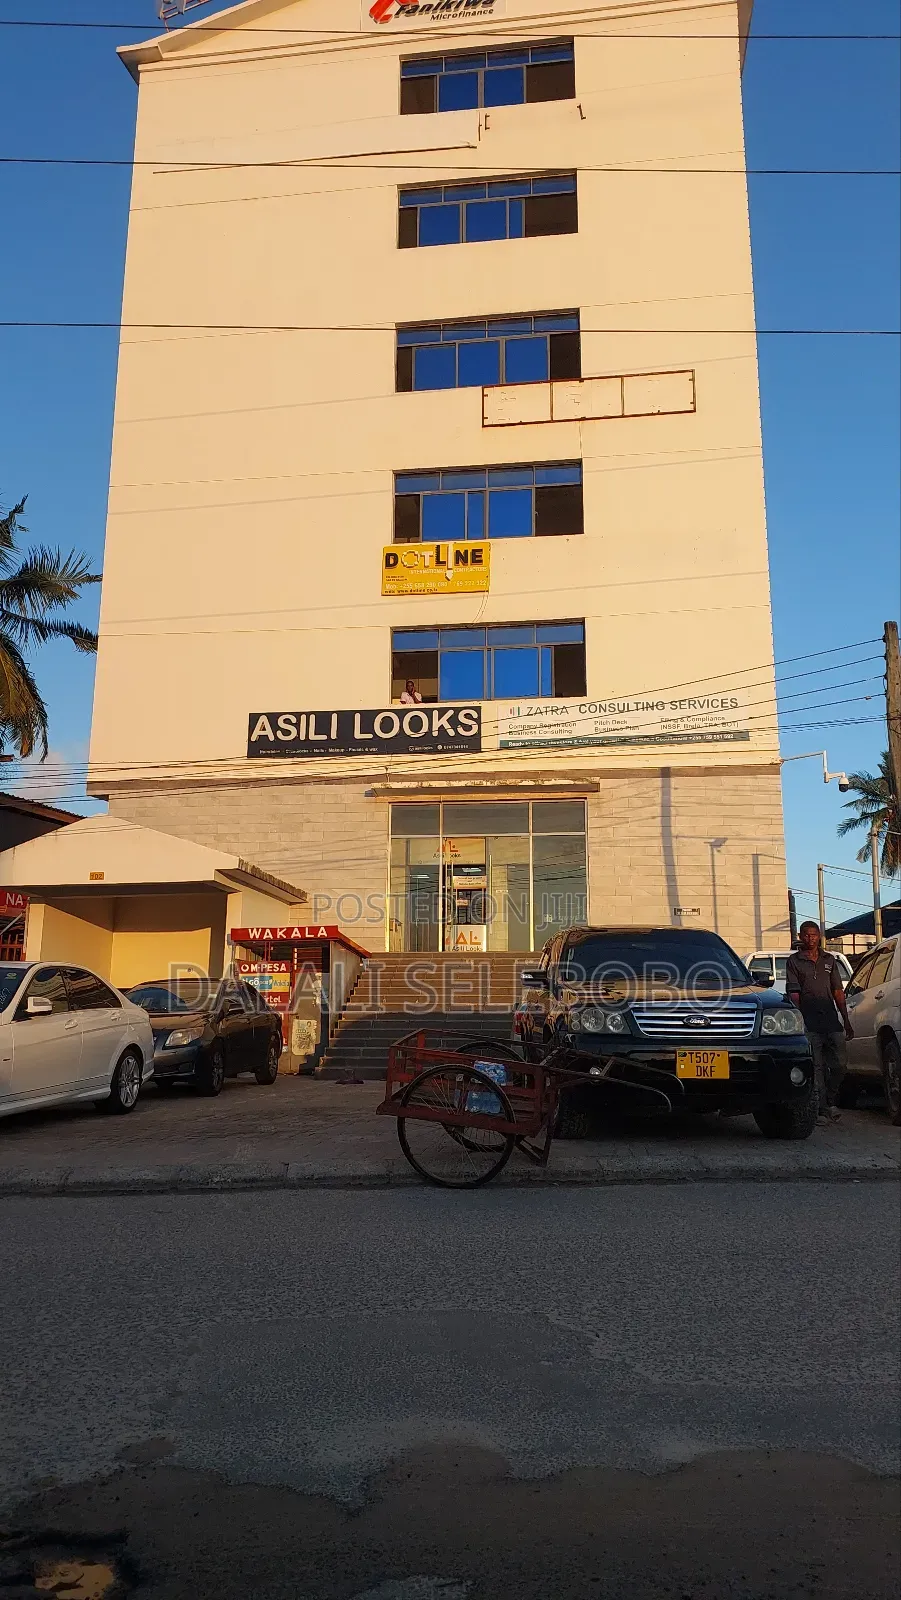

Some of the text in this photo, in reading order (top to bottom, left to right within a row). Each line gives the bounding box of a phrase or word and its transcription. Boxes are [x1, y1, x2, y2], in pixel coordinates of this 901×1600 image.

[430, 8, 494, 22] Microfinance
[385, 544, 484, 574] DOTLINE
[526, 697, 739, 716] ZATRA CONSULTING SERVICES
[250, 708, 479, 742] ASILI LOOKS
[686, 715, 725, 723] Compliance
[508, 723, 537, 731] Company
[248, 926, 328, 940] WAKALA
[251, 963, 287, 972] M-PESA
[688, 1051, 716, 1064] T507
[696, 1065, 717, 1077] DKF
